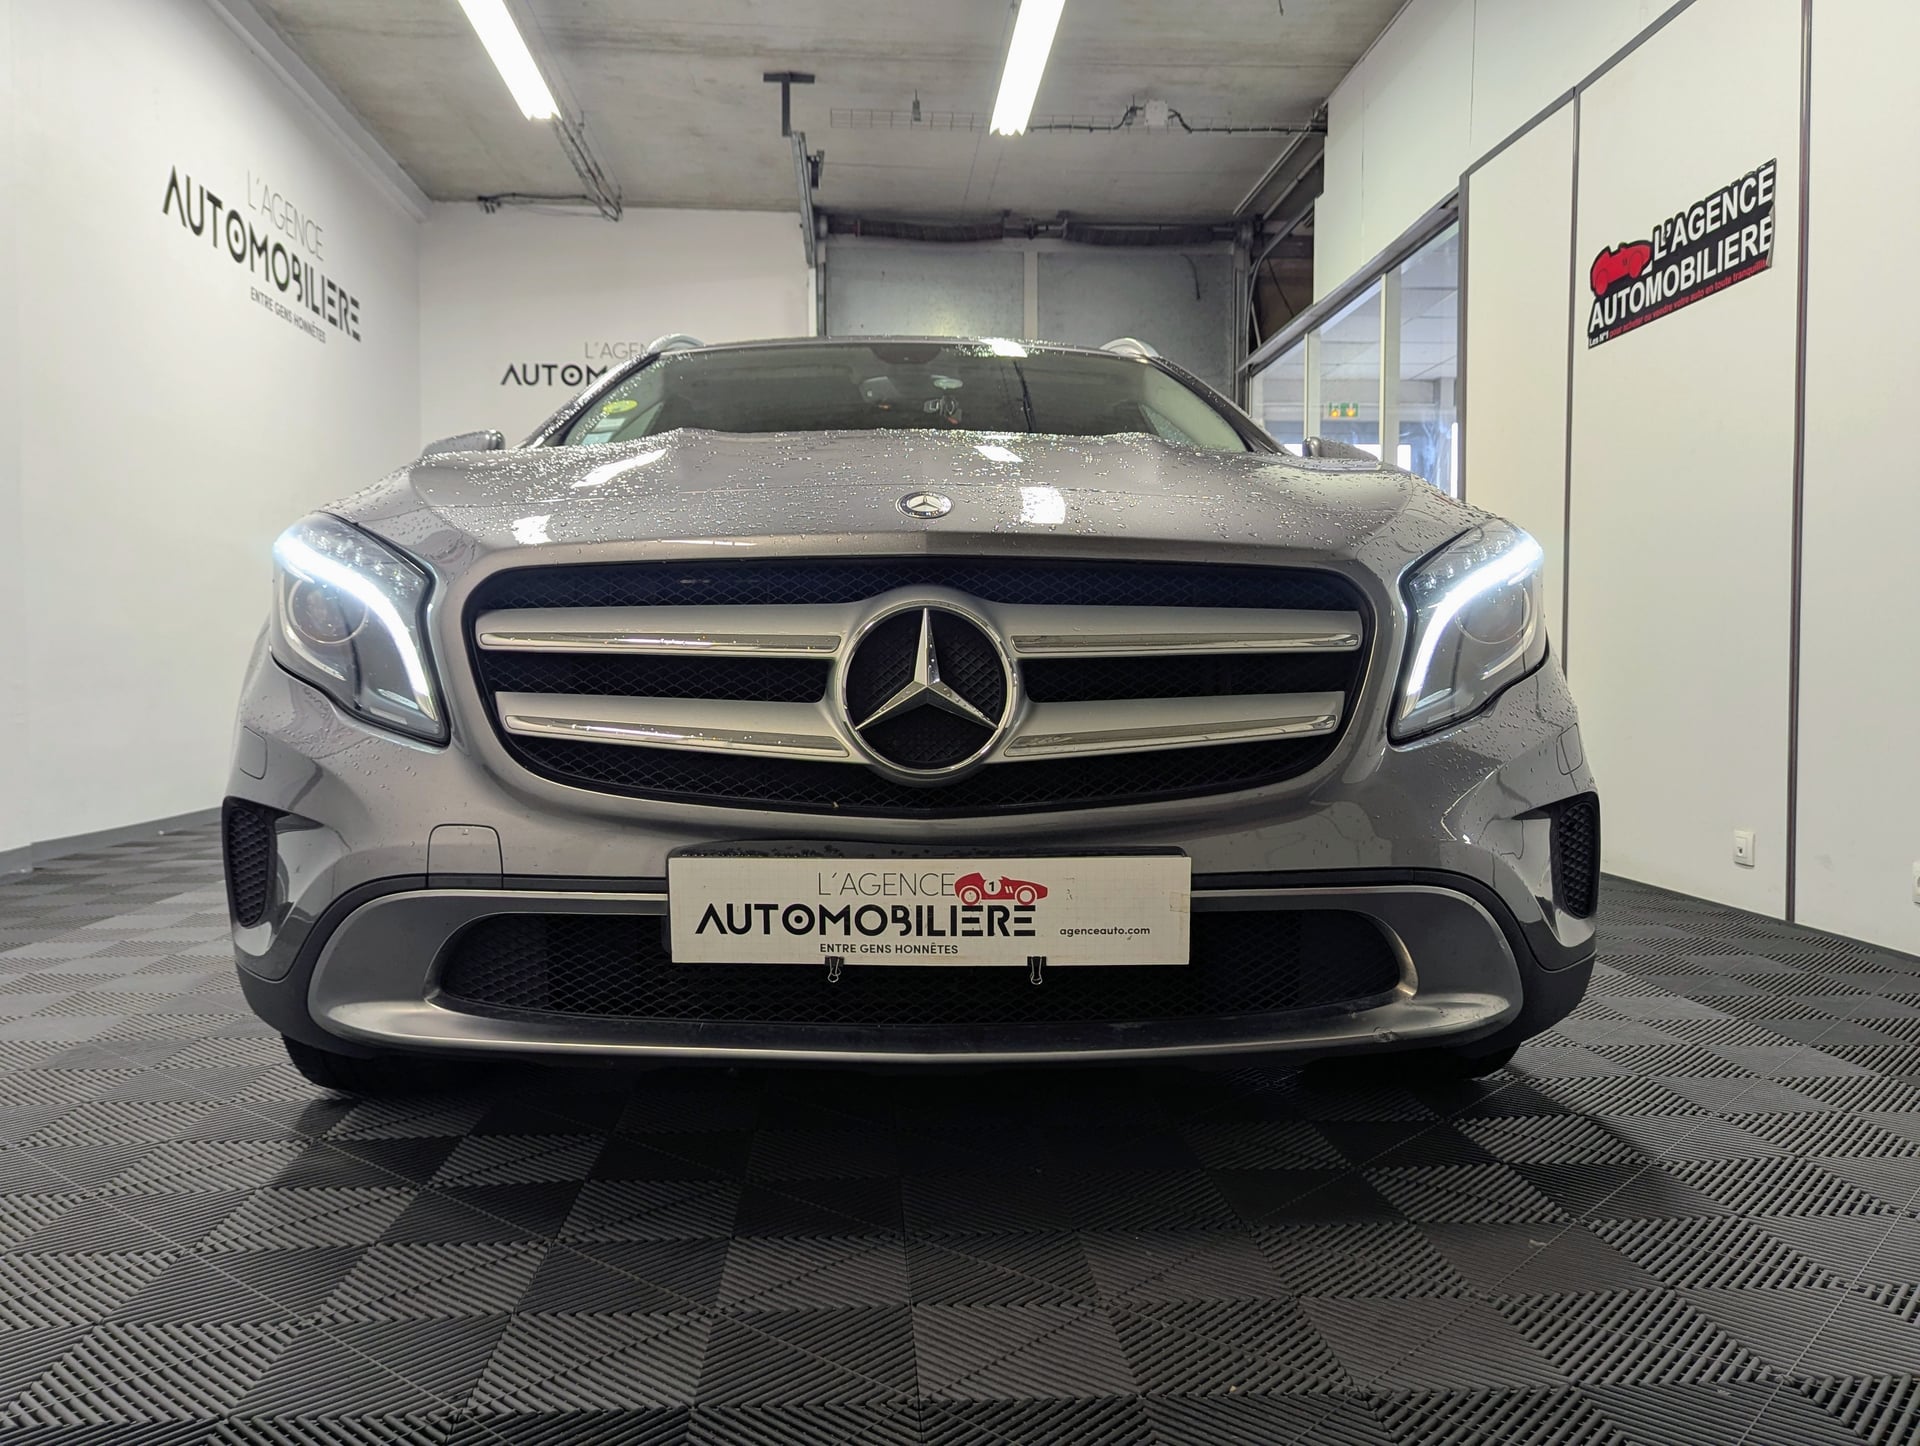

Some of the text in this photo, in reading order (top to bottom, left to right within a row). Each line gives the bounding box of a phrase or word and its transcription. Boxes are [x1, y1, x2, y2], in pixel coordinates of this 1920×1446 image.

[247, 168, 325, 262] L'AGENCE
[1654, 165, 1775, 262] L'AGENCE
[162, 164, 362, 342] AUTOMOBILIERE
[1589, 215, 1773, 334] AUTOMOBILIERE
[818, 872, 956, 897] L'AGENCE
[694, 902, 1037, 938] AUTOMOBILIERE
[819, 942, 959, 955] ENTRE GENS HONNÊTES
[1059, 926, 1151, 938] agenceauto.com
